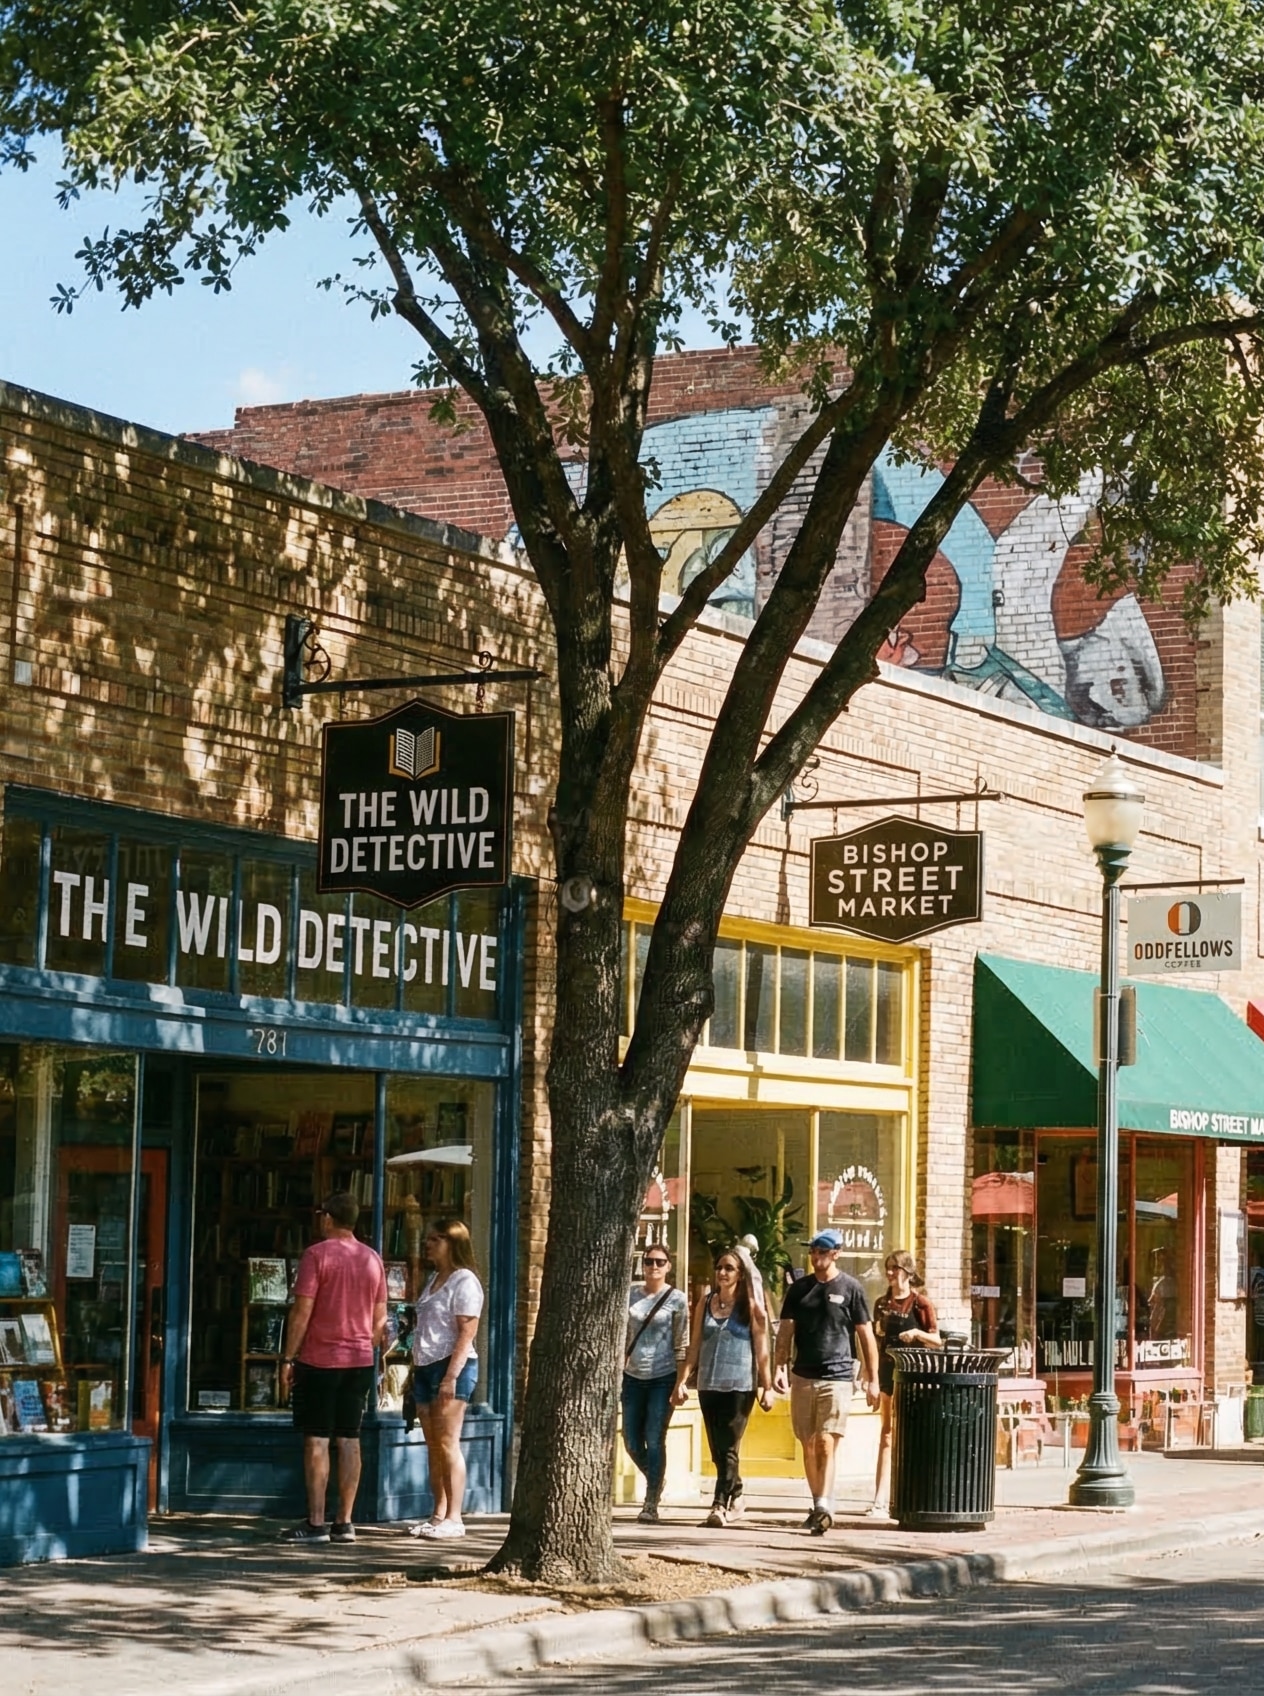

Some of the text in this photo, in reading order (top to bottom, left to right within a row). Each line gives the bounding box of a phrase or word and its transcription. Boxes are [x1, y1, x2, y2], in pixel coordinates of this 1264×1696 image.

[339, 787, 489, 828] THE WILD
[330, 831, 495, 874] DETECTIVE
[843, 841, 948, 864] BISHOP
[828, 865, 964, 894] STREET
[838, 895, 953, 918] MARKET
[53, 870, 498, 991] THE WILD DETECTIVE
[1134, 940, 1233, 960] ODDFELLOWS
[254, 1028, 287, 1056] 781
[1169, 1109, 1209, 1131] BISHOP
[1211, 1113, 1249, 1135] STREET
